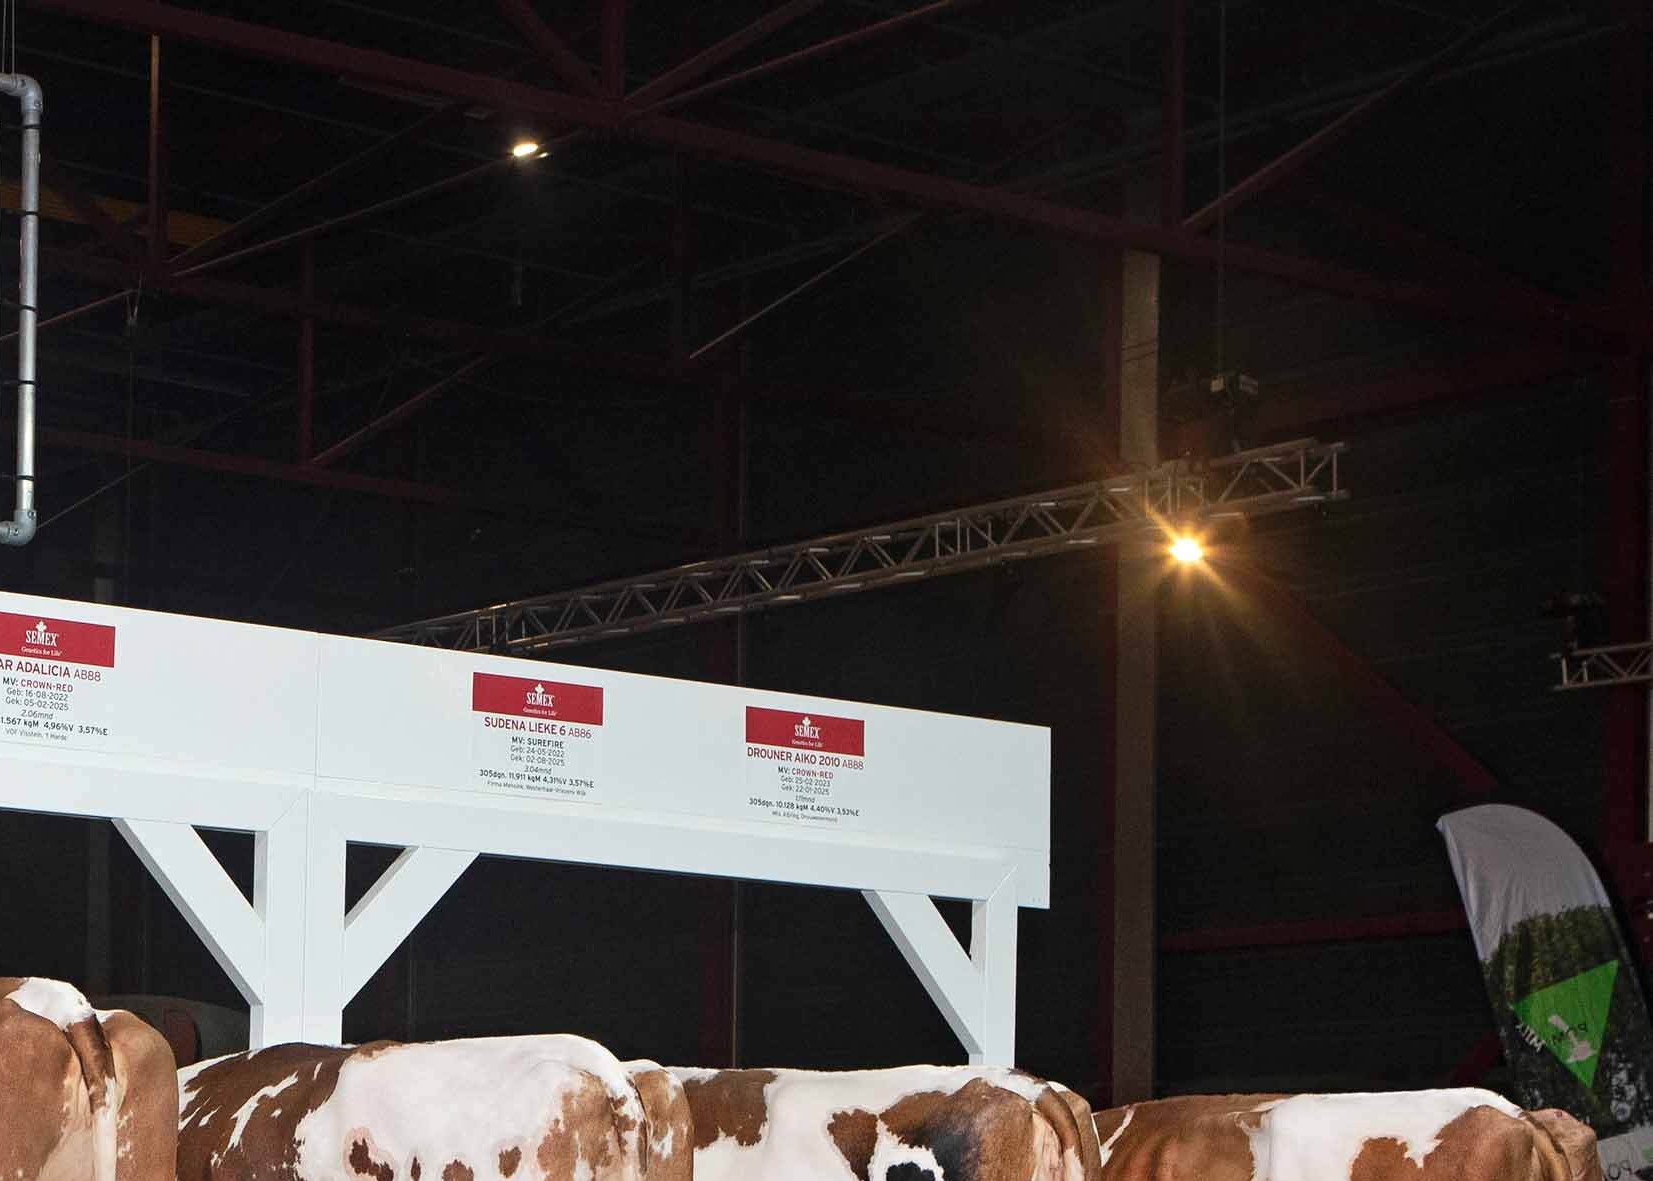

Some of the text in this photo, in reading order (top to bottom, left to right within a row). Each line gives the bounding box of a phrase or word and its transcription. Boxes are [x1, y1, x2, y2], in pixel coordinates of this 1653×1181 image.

[26, 631, 57, 647] SEMEX
[16, 663, 71, 678] ADALICIA
[74, 669, 101, 682] AB88
[3, 677, 73, 692] MV: CROWN-RED
[527, 692, 554, 707] SEMEX
[485, 717, 526, 731] SUDENA
[529, 723, 557, 735] LIEKE
[560, 726, 565, 735] 6
[795, 725, 820, 739] SEMEX
[512, 736, 564, 748] MV: SUREFIRE
[747, 747, 792, 762] DROUNER
[795, 753, 816, 765] AIKO
[819, 755, 840, 767] 2010
[778, 766, 833, 779] MV: CROWN-RED
